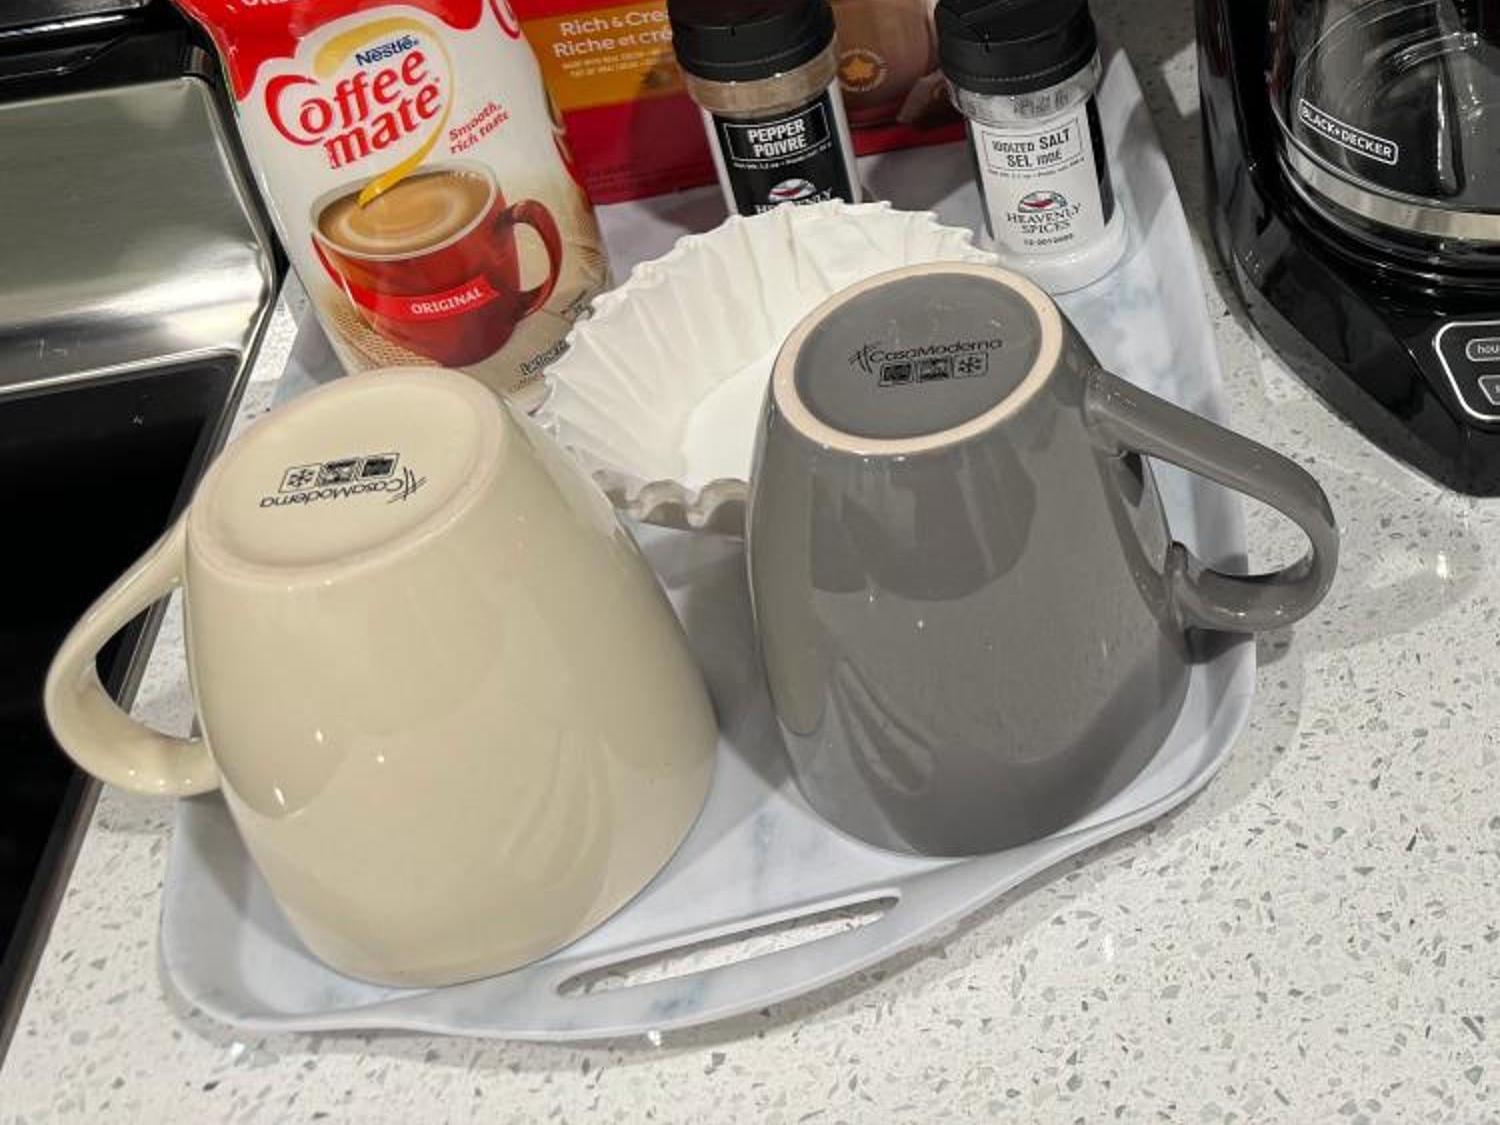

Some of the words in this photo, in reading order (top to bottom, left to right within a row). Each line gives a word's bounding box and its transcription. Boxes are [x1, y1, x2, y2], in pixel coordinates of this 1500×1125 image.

[560, 17, 610, 36] Rich
[355, 34, 414, 66] Nestlé
[553, 35, 616, 58] Riche
[618, 33, 636, 46] et
[264, 50, 429, 146] Coffee
[323, 83, 442, 170] mate
[747, 118, 806, 143] PEPPER
[1302, 105, 1393, 159] BLACK+DECKER
[450, 133, 480, 155] rich
[753, 134, 807, 158] POIVRE
[1038, 128, 1071, 151] SALT
[1006, 154, 1033, 168] SEL
[1006, 202, 1083, 225] HEAVENLY
[1021, 221, 1072, 235] SPICES
[411, 287, 483, 316] ORIGINAL
[868, 338, 1003, 364] CasaModerna
[259, 477, 404, 509] CasaModerna
